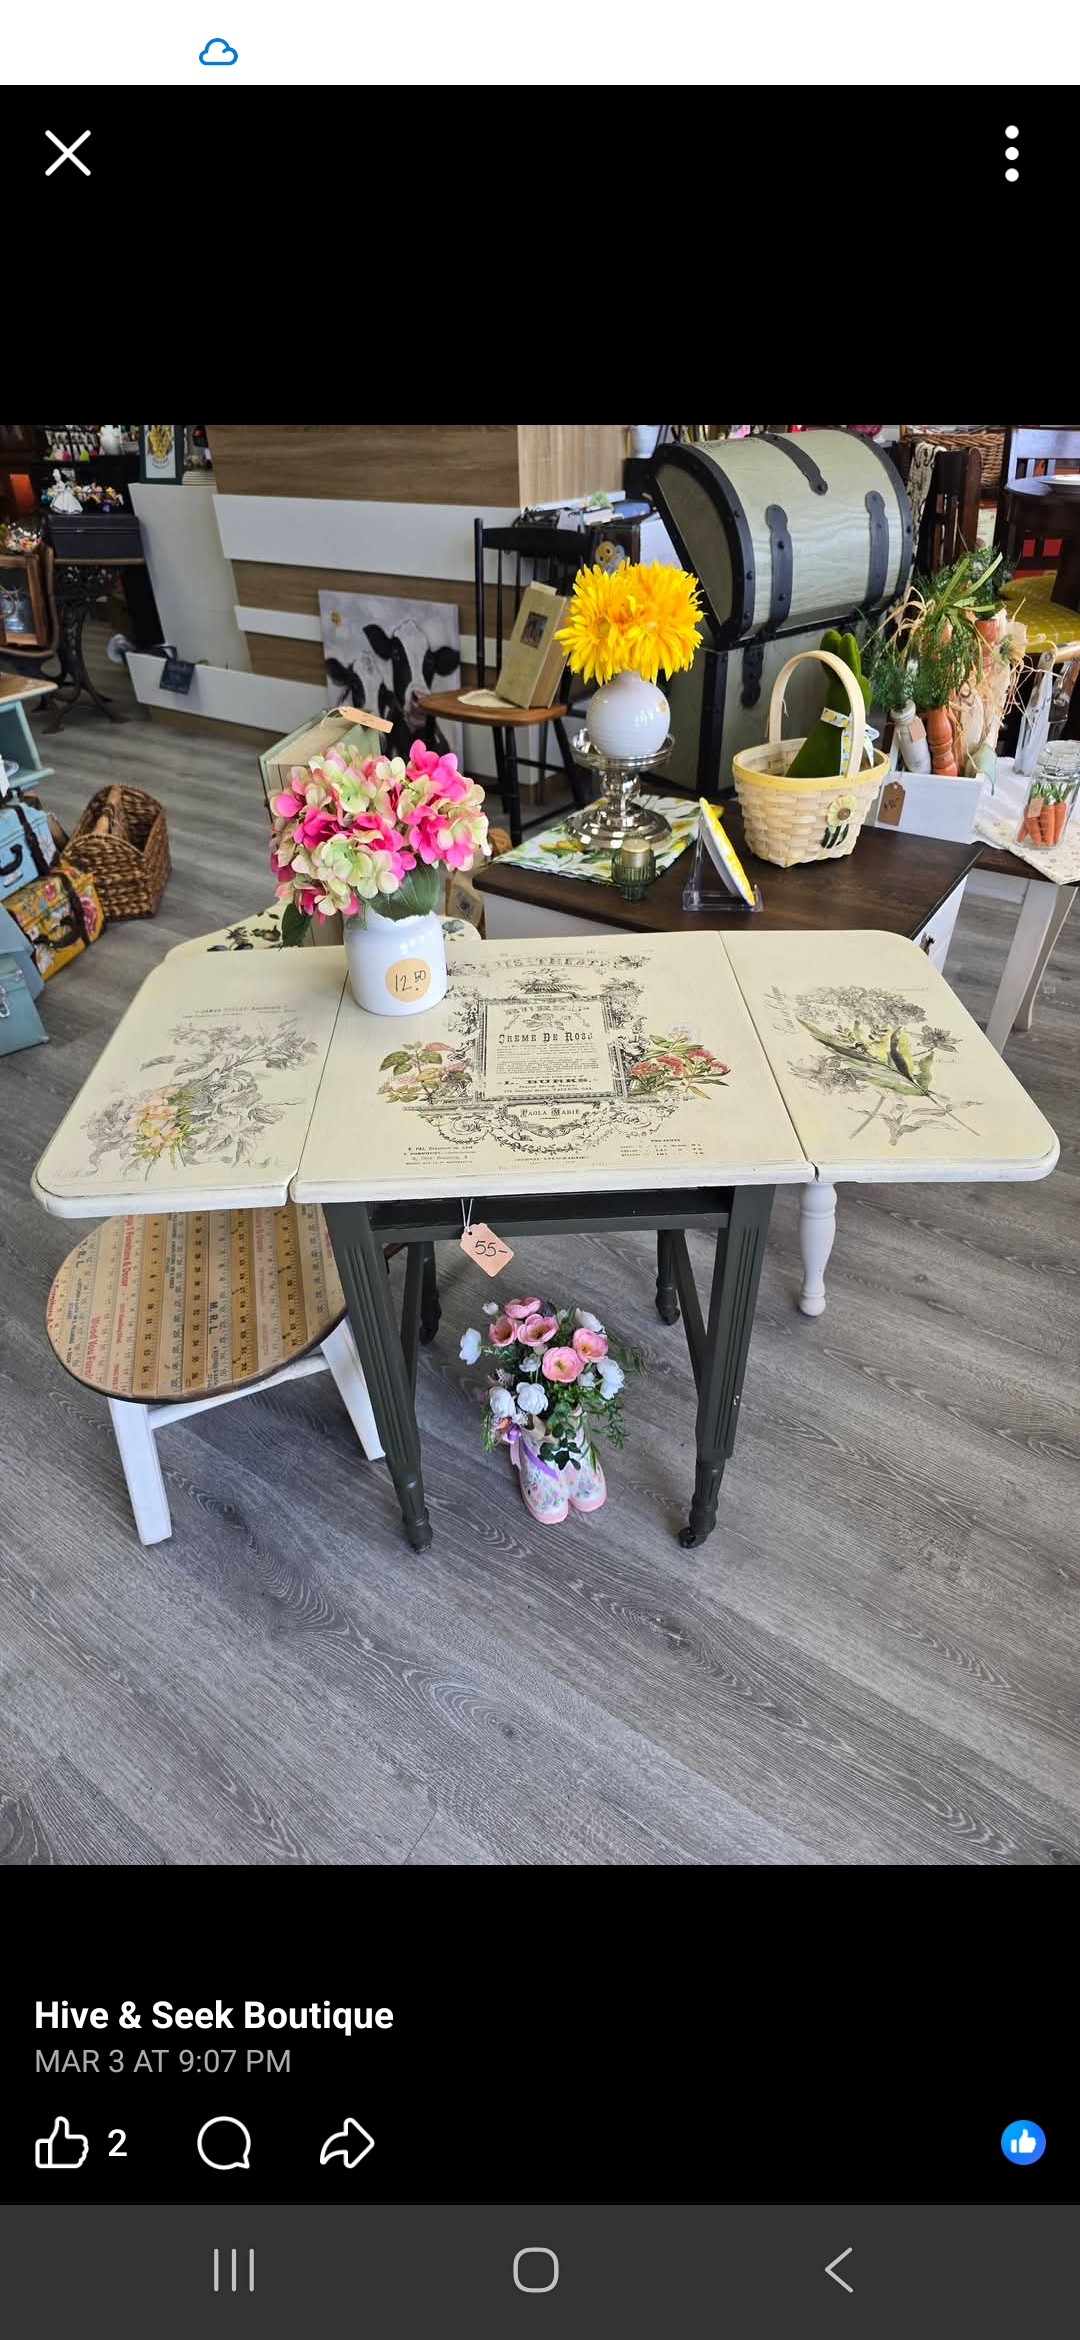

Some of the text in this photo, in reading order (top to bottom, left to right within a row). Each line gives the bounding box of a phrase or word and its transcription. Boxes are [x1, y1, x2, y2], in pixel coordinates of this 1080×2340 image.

[394, 969, 427, 992] 12.50
[498, 1034, 537, 1044] CREME
[543, 1032, 558, 1042] DE
[520, 1107, 581, 1118] PAOLA MARIE
[120, 1267, 132, 1287] Decor
[87, 1339, 99, 1355] You
